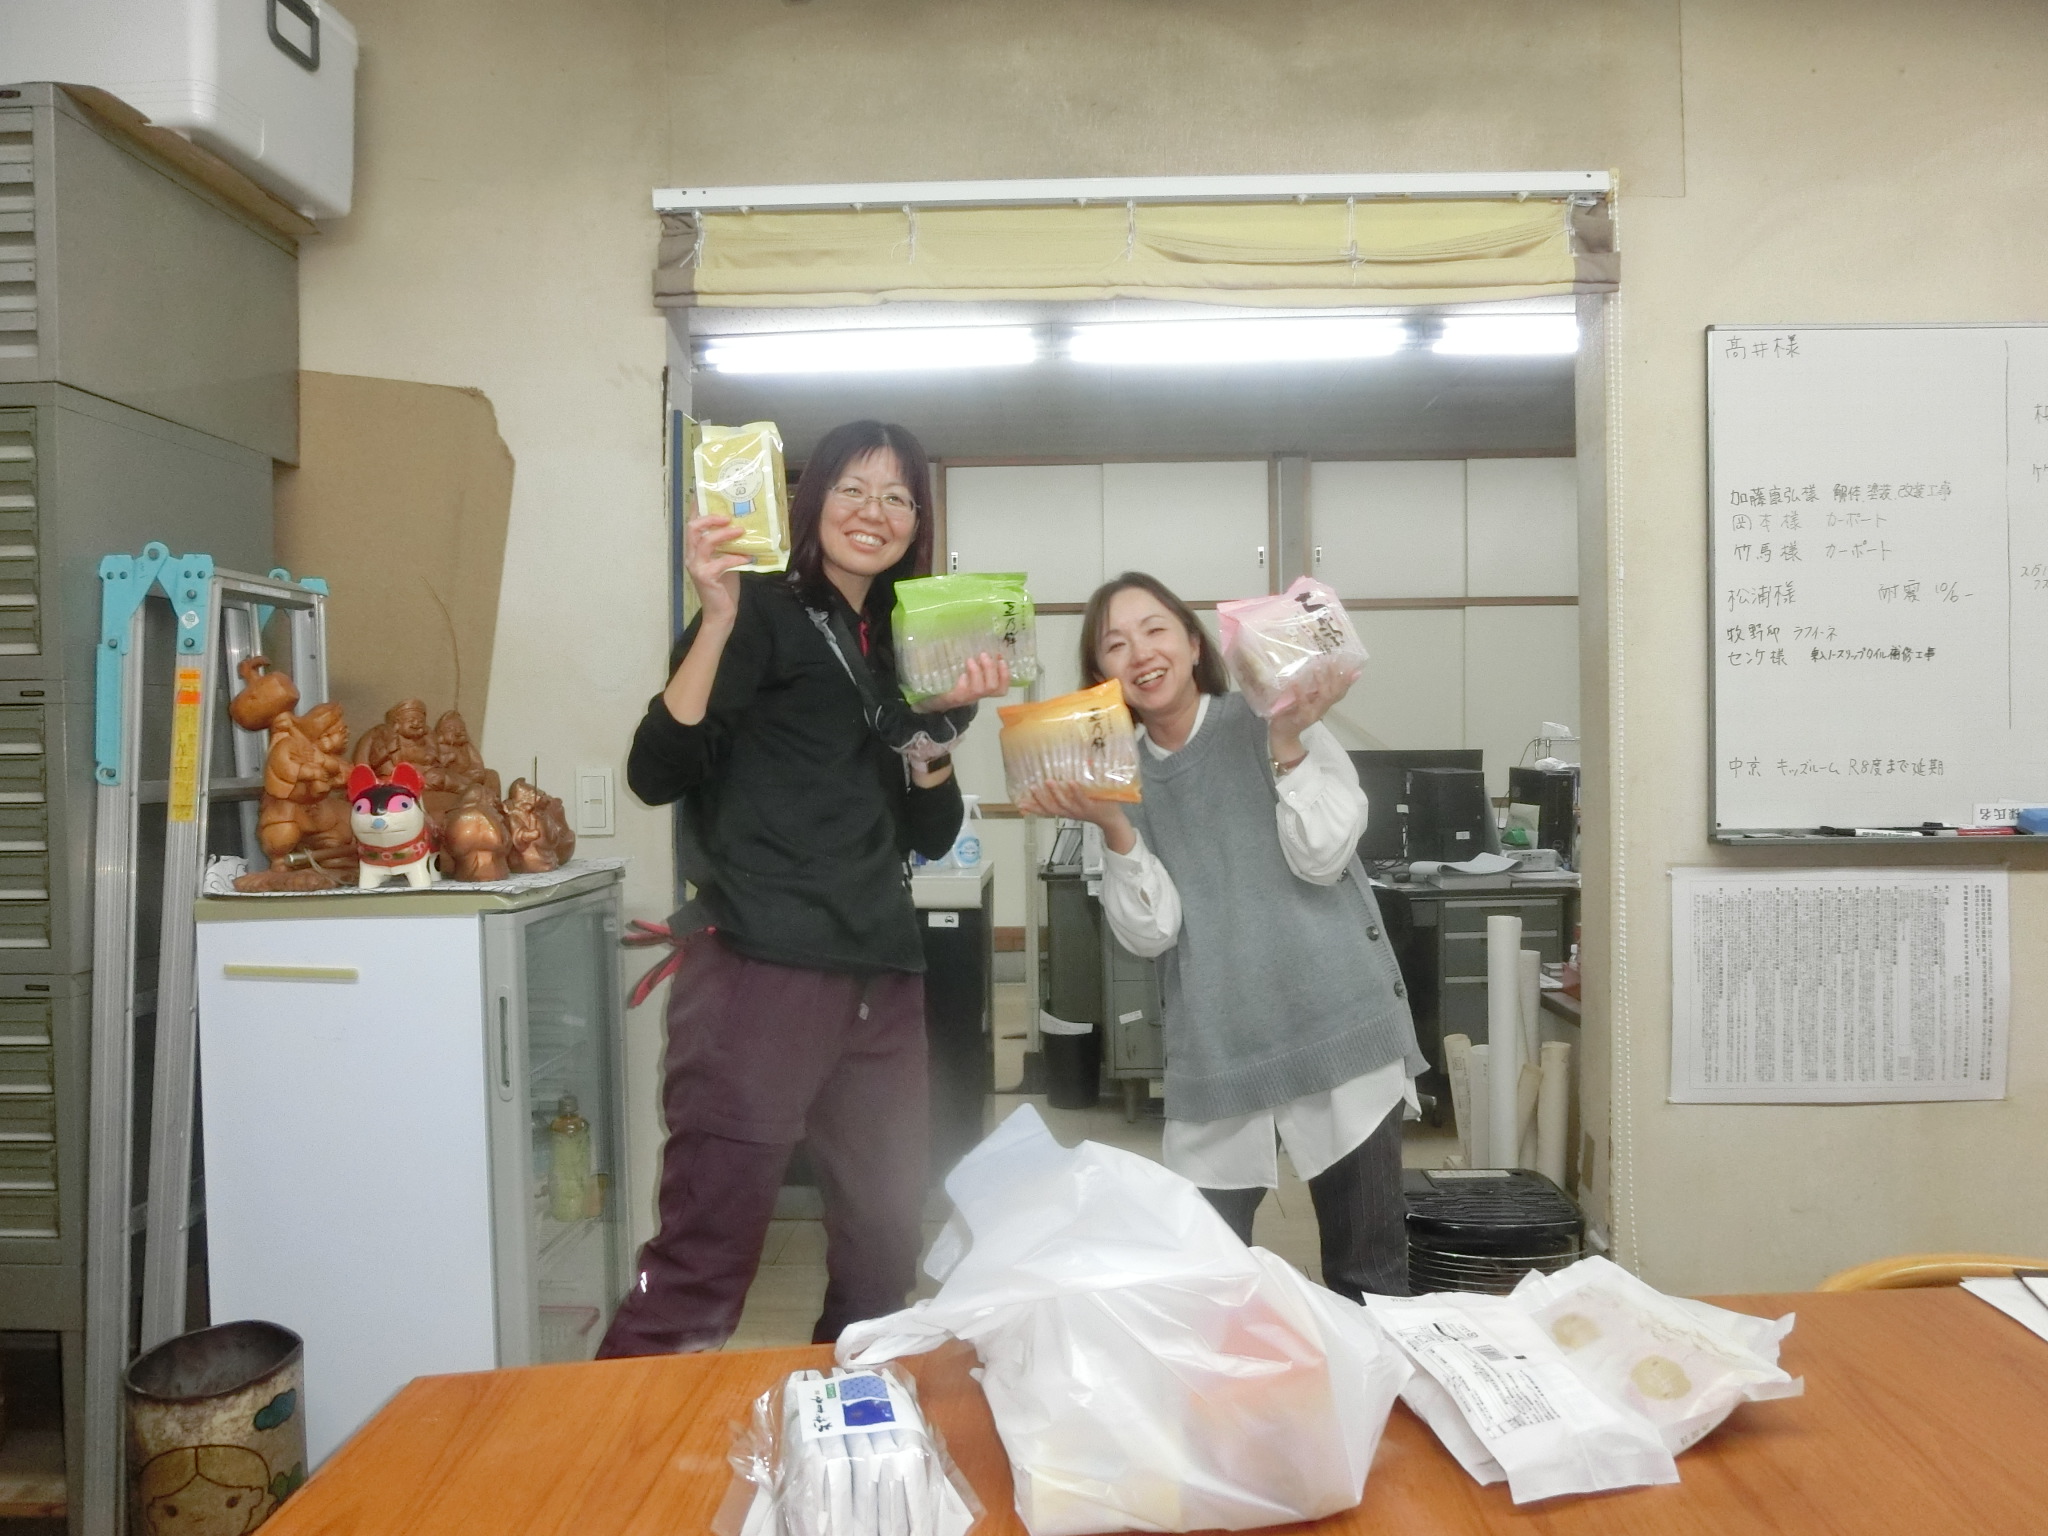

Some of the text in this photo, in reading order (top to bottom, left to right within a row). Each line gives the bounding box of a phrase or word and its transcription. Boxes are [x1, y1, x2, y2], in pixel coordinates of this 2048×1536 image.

[1826, 511, 1887, 528] カーポート
[1826, 539, 1892, 561] カーポート
[1879, 579, 1920, 603] 耐震
[1777, 757, 1840, 775] キッズルーム
